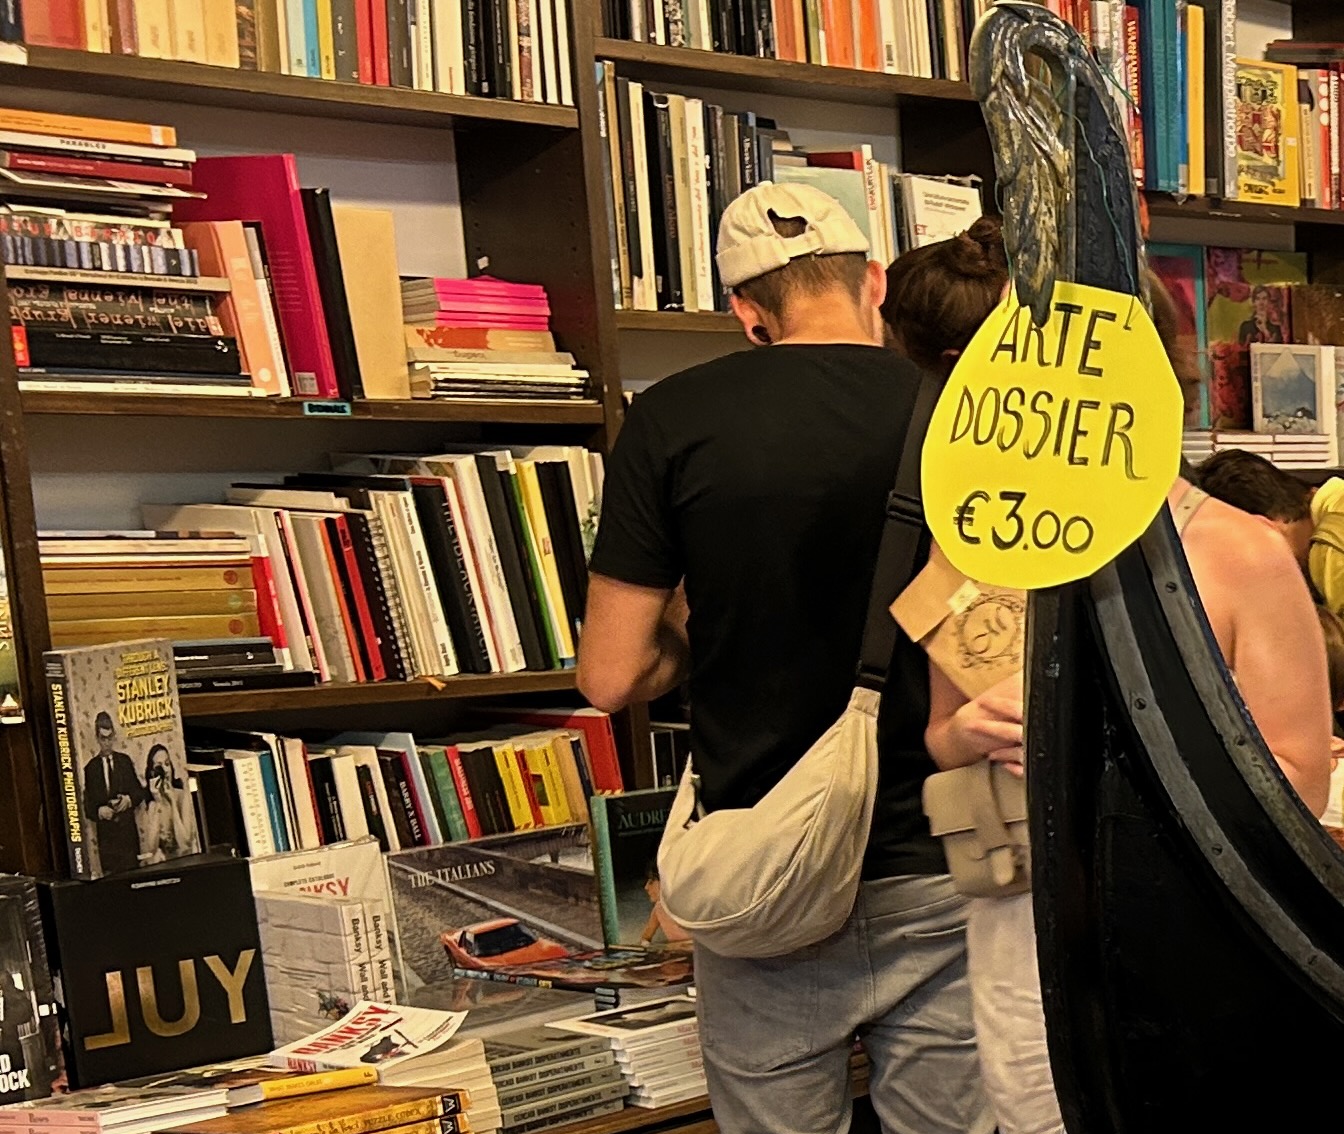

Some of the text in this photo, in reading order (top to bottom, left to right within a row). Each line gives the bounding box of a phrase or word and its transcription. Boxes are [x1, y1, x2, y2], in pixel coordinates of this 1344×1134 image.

[1225, 50, 1237, 158] Mapplethorpe
[950, 385, 1148, 480] DOSSIER
[953, 490, 1094, 553] €3.00
[116, 675, 170, 701] STANLEY
[117, 698, 176, 727] KUBRICK
[50, 683, 82, 843] STANLEY KUBRICK PHOTOGRAPHS
[408, 860, 495, 889] THE ITALIANS
[351, 918, 367, 984] Banksy Wall
[372, 915, 389, 982] Banksy Wall
[292, 1005, 394, 1056] BANKSY
